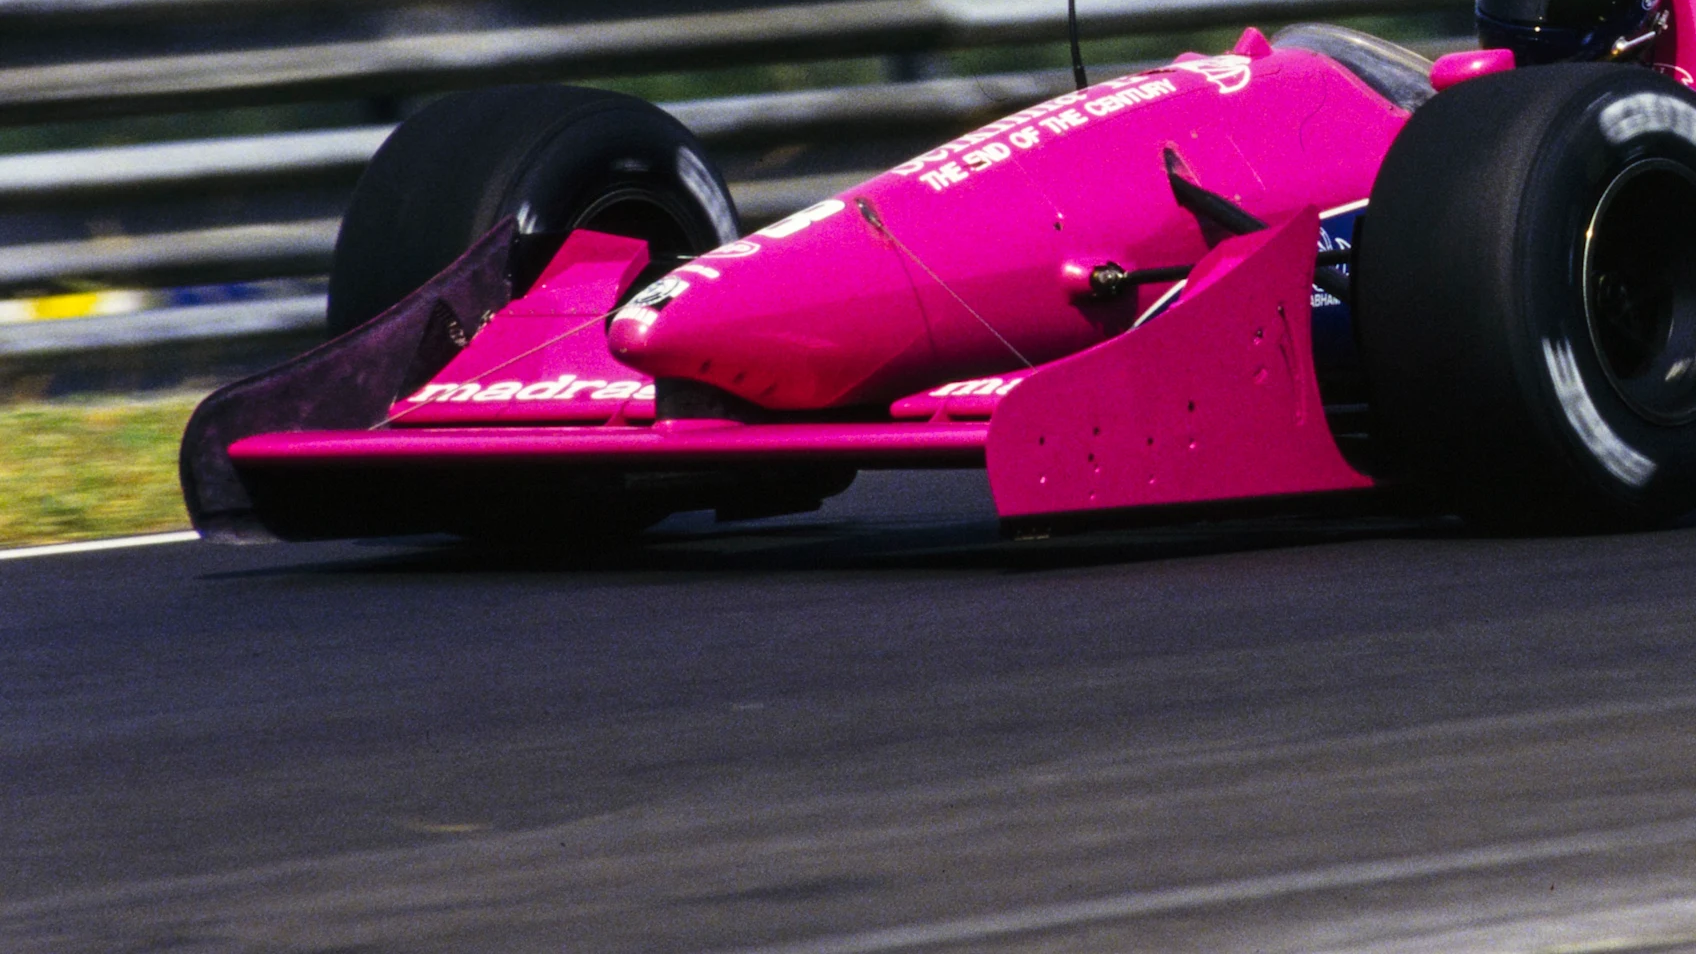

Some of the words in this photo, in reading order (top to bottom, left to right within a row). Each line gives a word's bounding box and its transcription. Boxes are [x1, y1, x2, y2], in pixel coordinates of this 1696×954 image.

[919, 161, 969, 191] THE
[968, 144, 1011, 172] END
[1010, 125, 1042, 149] OF
[1038, 108, 1089, 135] THE
[1084, 77, 1177, 117] CENTURY
